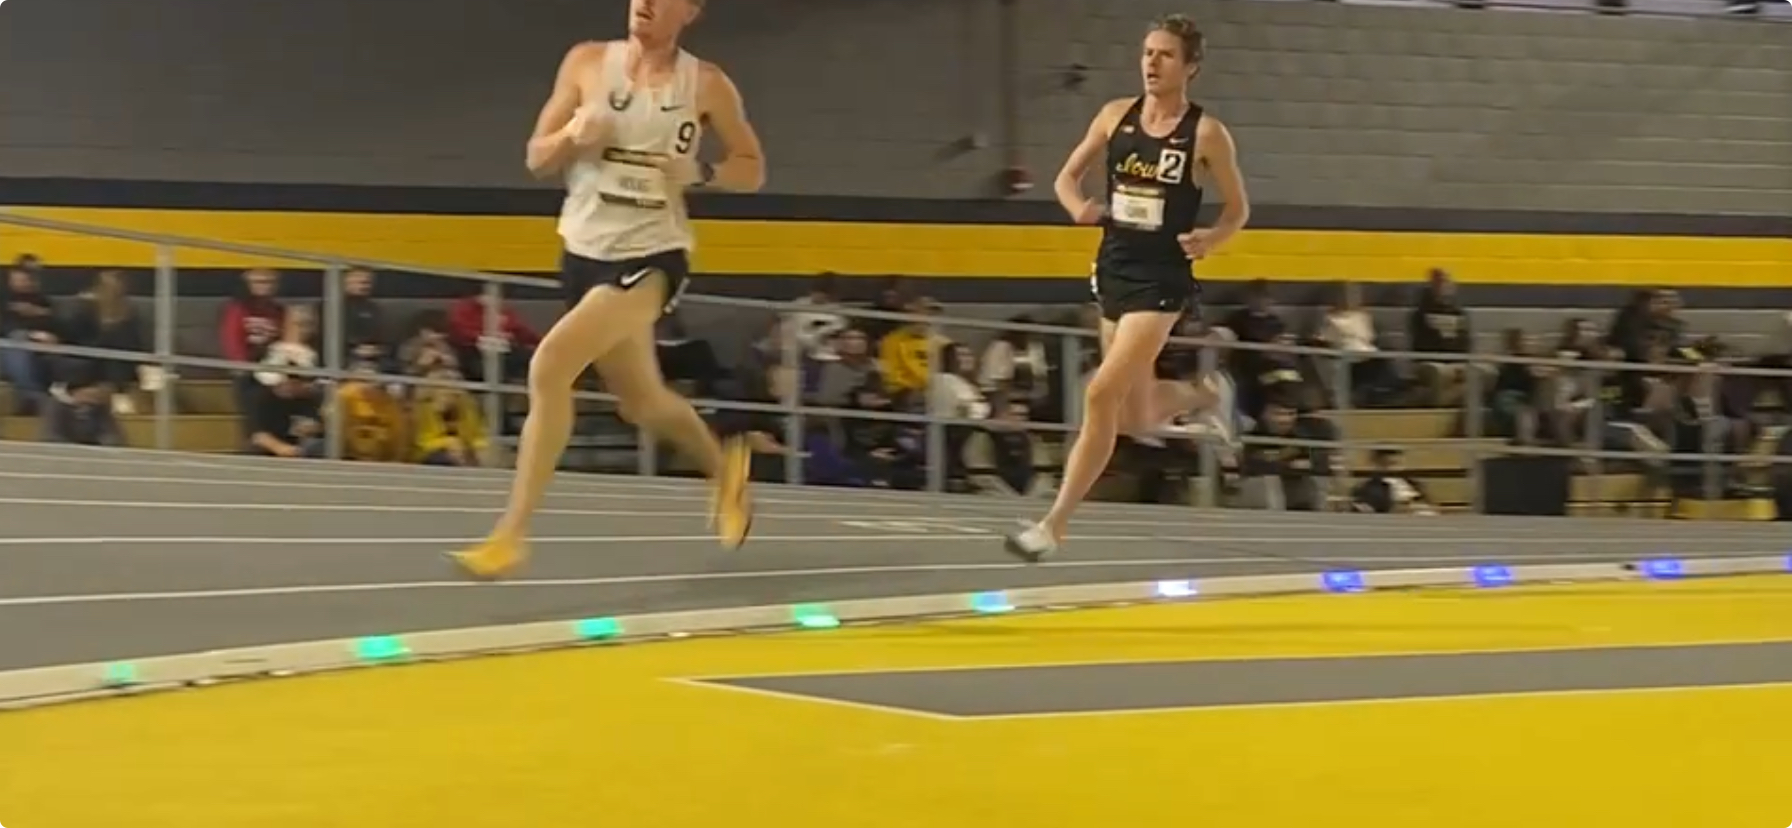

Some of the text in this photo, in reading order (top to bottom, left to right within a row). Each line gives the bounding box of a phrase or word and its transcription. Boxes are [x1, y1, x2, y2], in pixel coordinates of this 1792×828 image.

[676, 122, 695, 154] 9
[1115, 153, 1159, 178] Iow
[1161, 154, 1182, 180] 2
